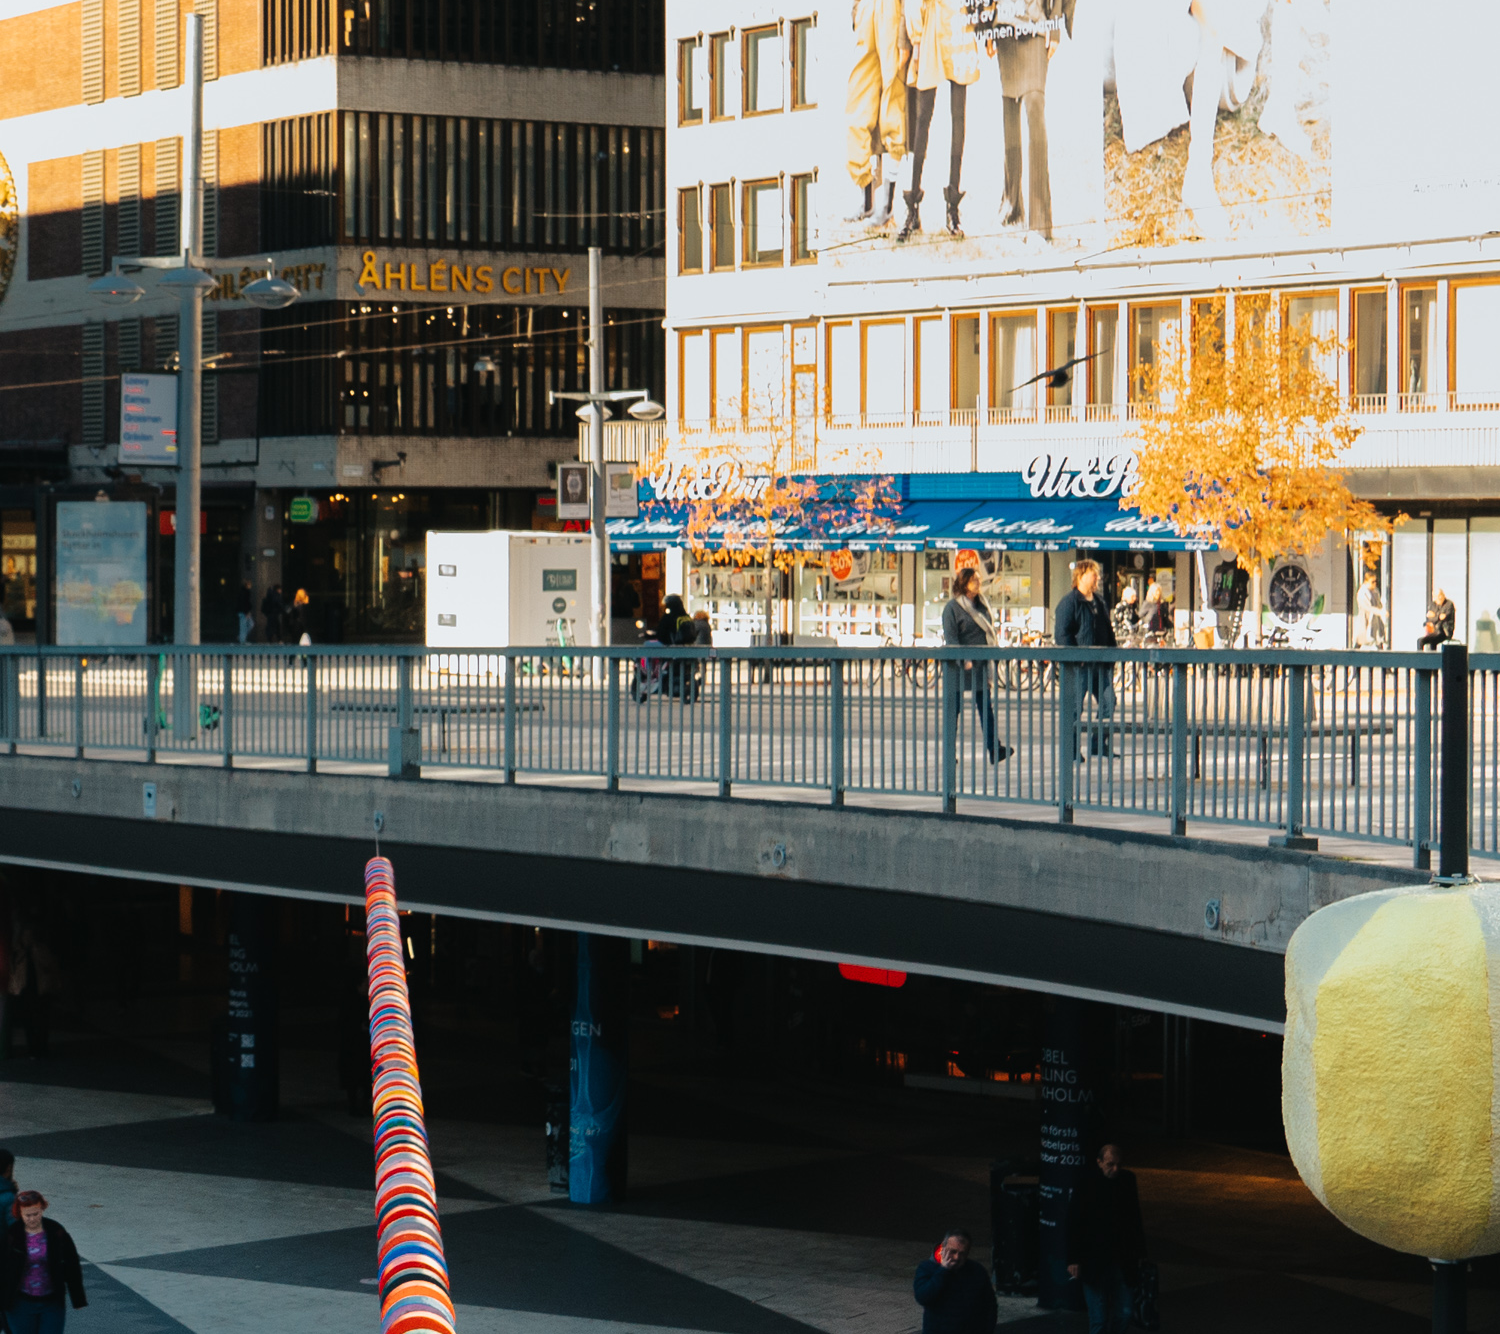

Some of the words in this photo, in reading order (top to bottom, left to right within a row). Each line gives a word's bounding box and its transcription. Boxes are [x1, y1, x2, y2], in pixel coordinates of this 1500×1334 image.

[358, 251, 494, 295] ÅHLÉNS
[502, 267, 572, 295] CITY
[570, 1021, 602, 1037] GEN
